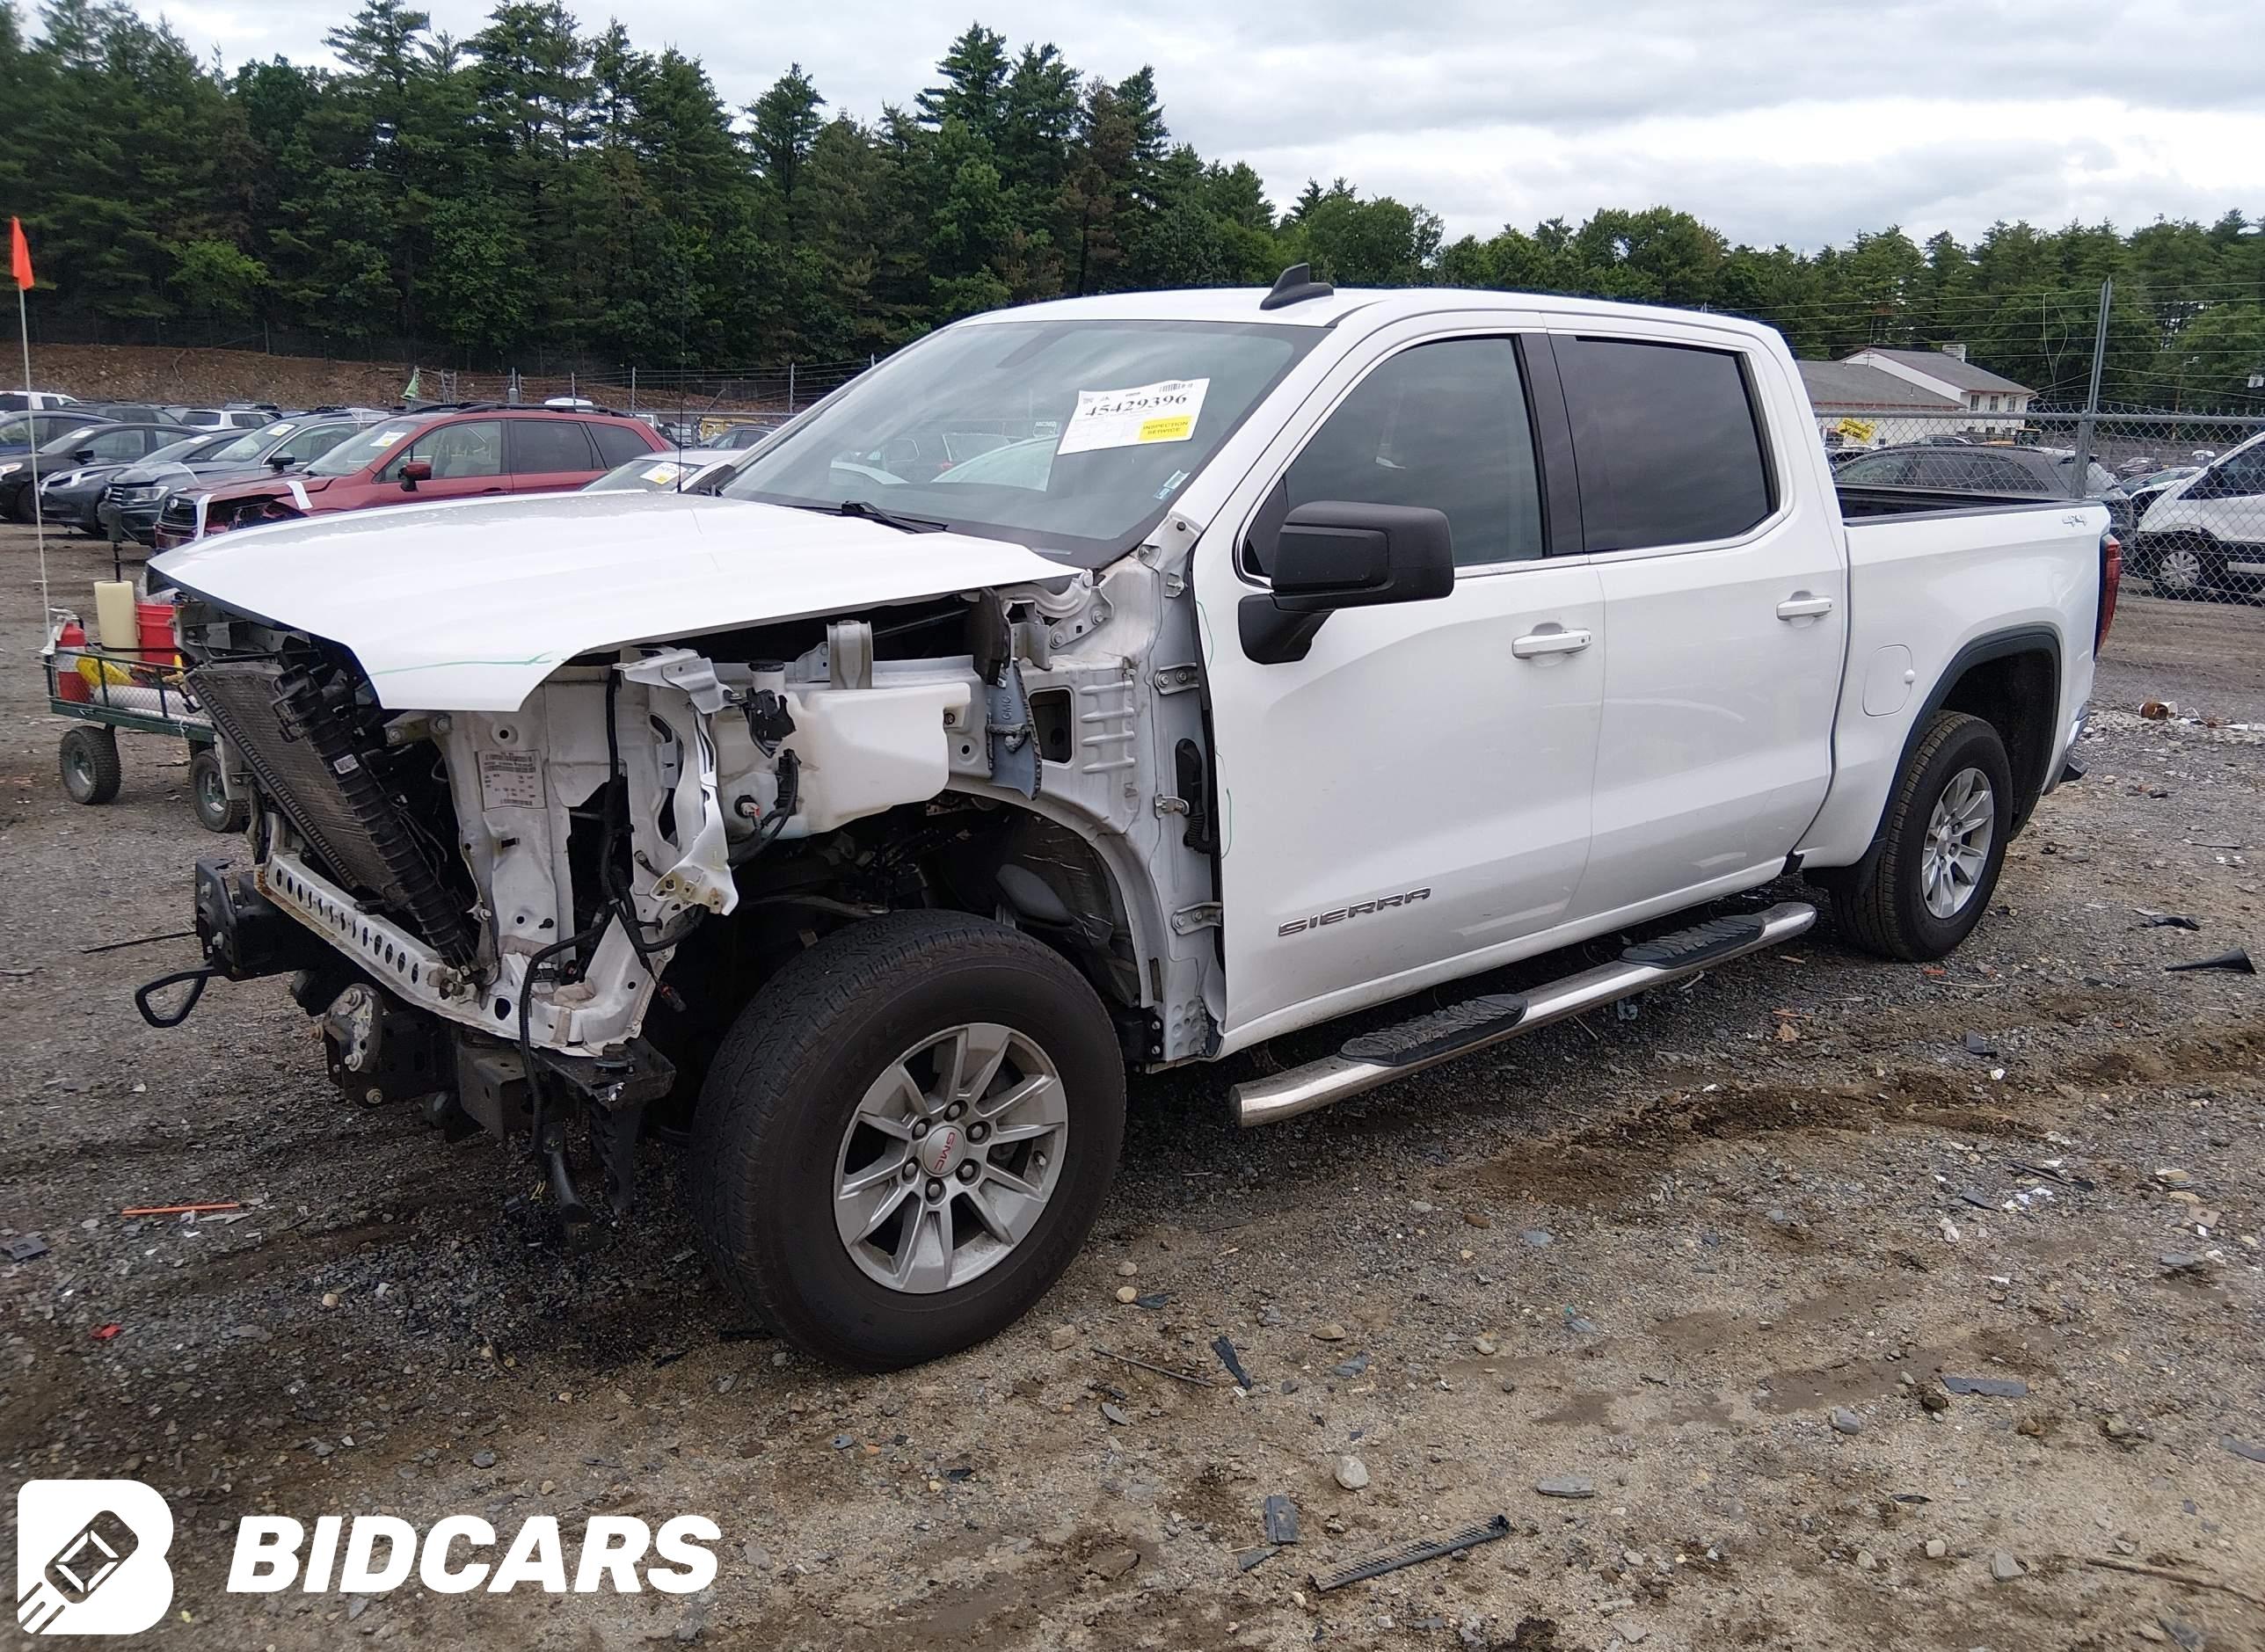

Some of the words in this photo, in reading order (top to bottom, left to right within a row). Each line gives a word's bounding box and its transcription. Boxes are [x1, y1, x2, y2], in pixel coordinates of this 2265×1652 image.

[1085, 394, 1187, 417] 45429396
[1001, 695, 1012, 720] GMC
[1278, 886, 1431, 937] SIERRA
[934, 1132, 956, 1171] GMC
